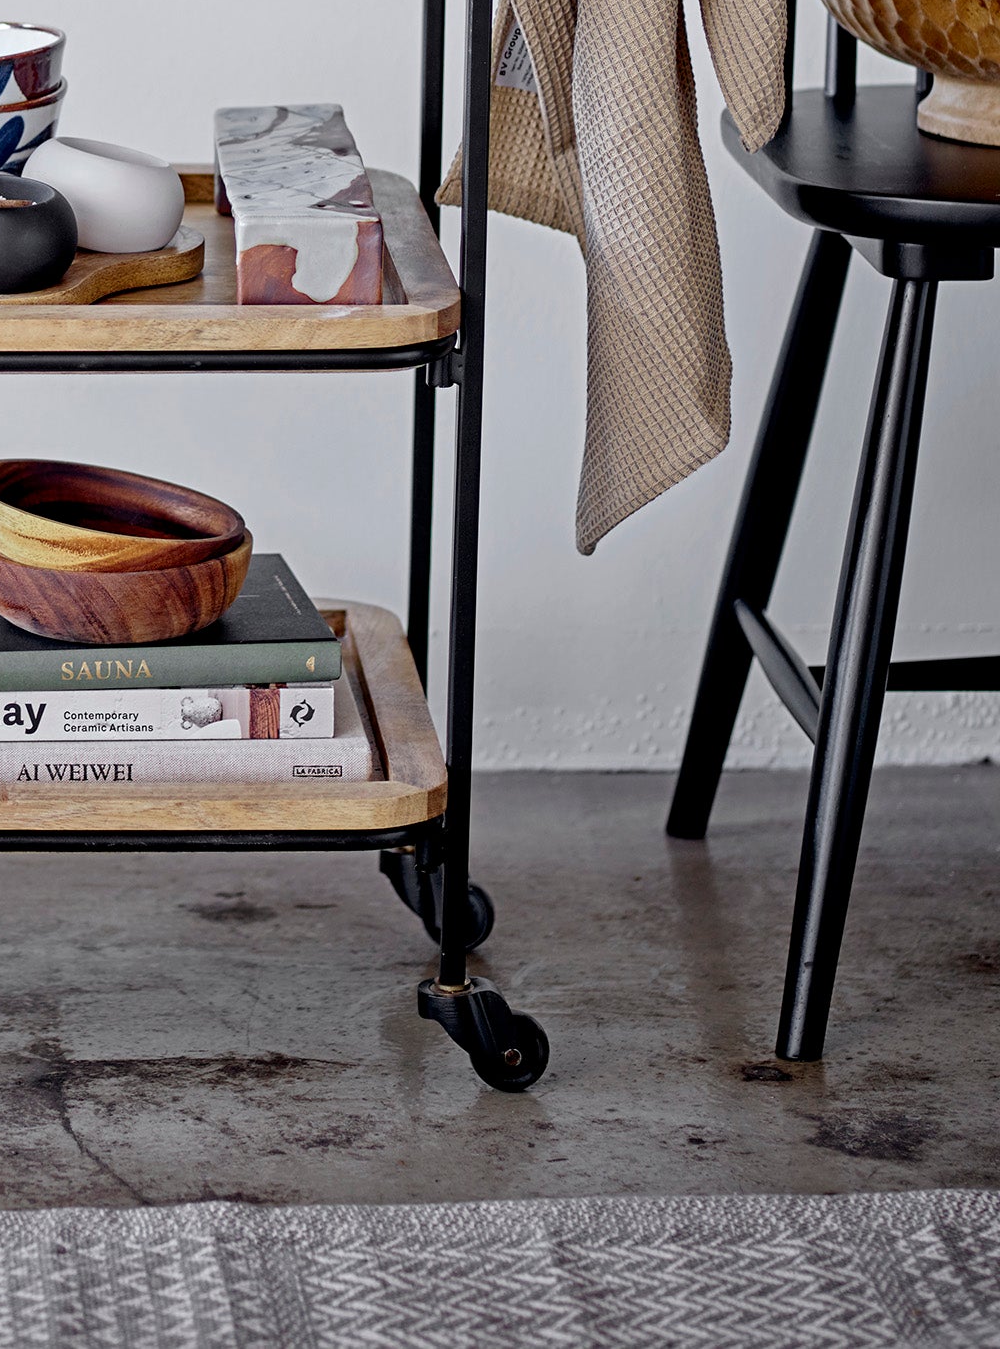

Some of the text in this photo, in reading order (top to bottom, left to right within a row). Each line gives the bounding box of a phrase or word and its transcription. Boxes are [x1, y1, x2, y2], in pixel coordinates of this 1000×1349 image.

[499, 62, 508, 76] BV
[504, 28, 522, 59] Group
[61, 659, 153, 681] SAUNA
[63, 711, 139, 722] Contemporary
[63, 723, 154, 732] Ceramic Artisans
[16, 763, 134, 782] AI WEIWEI
